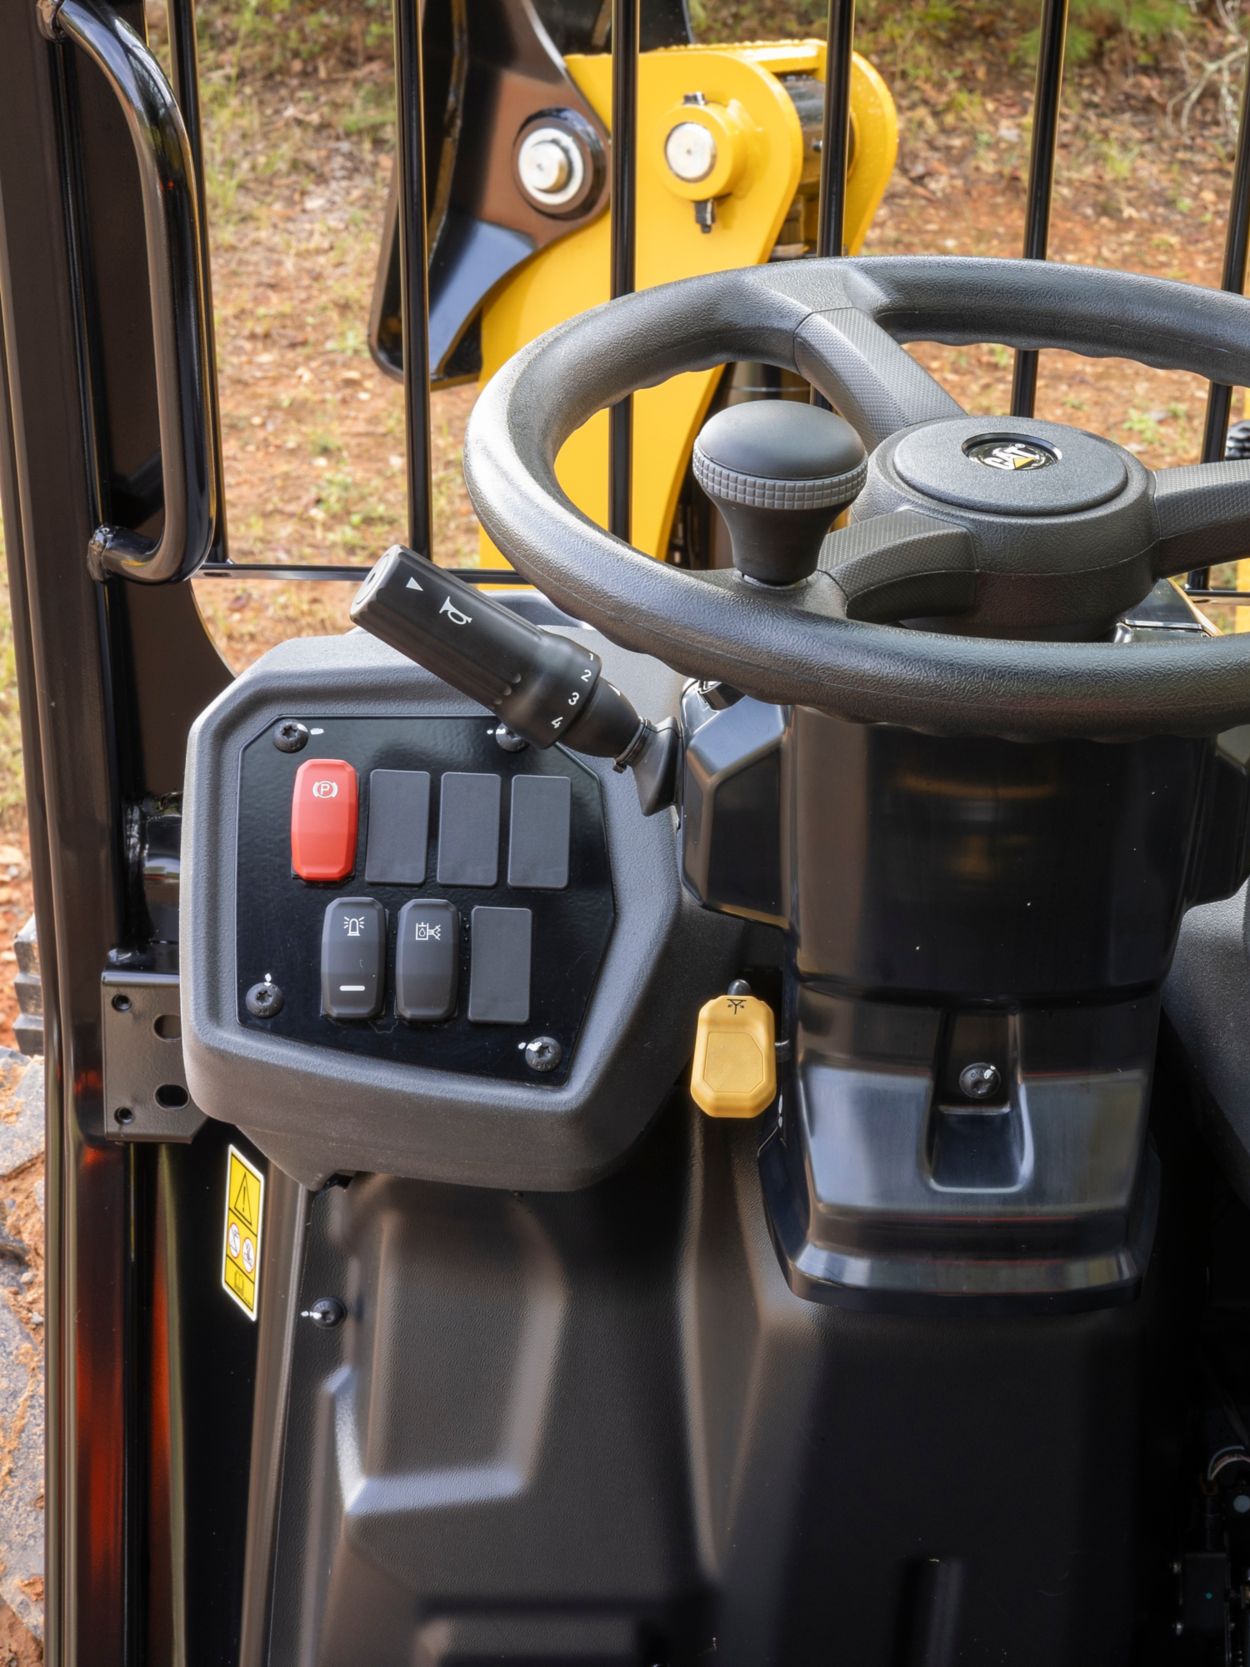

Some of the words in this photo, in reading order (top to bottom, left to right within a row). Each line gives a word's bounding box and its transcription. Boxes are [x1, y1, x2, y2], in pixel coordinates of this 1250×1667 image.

[580, 669, 592, 682] 2
[568, 692, 580, 705] 3
[551, 716, 564, 729] 4
